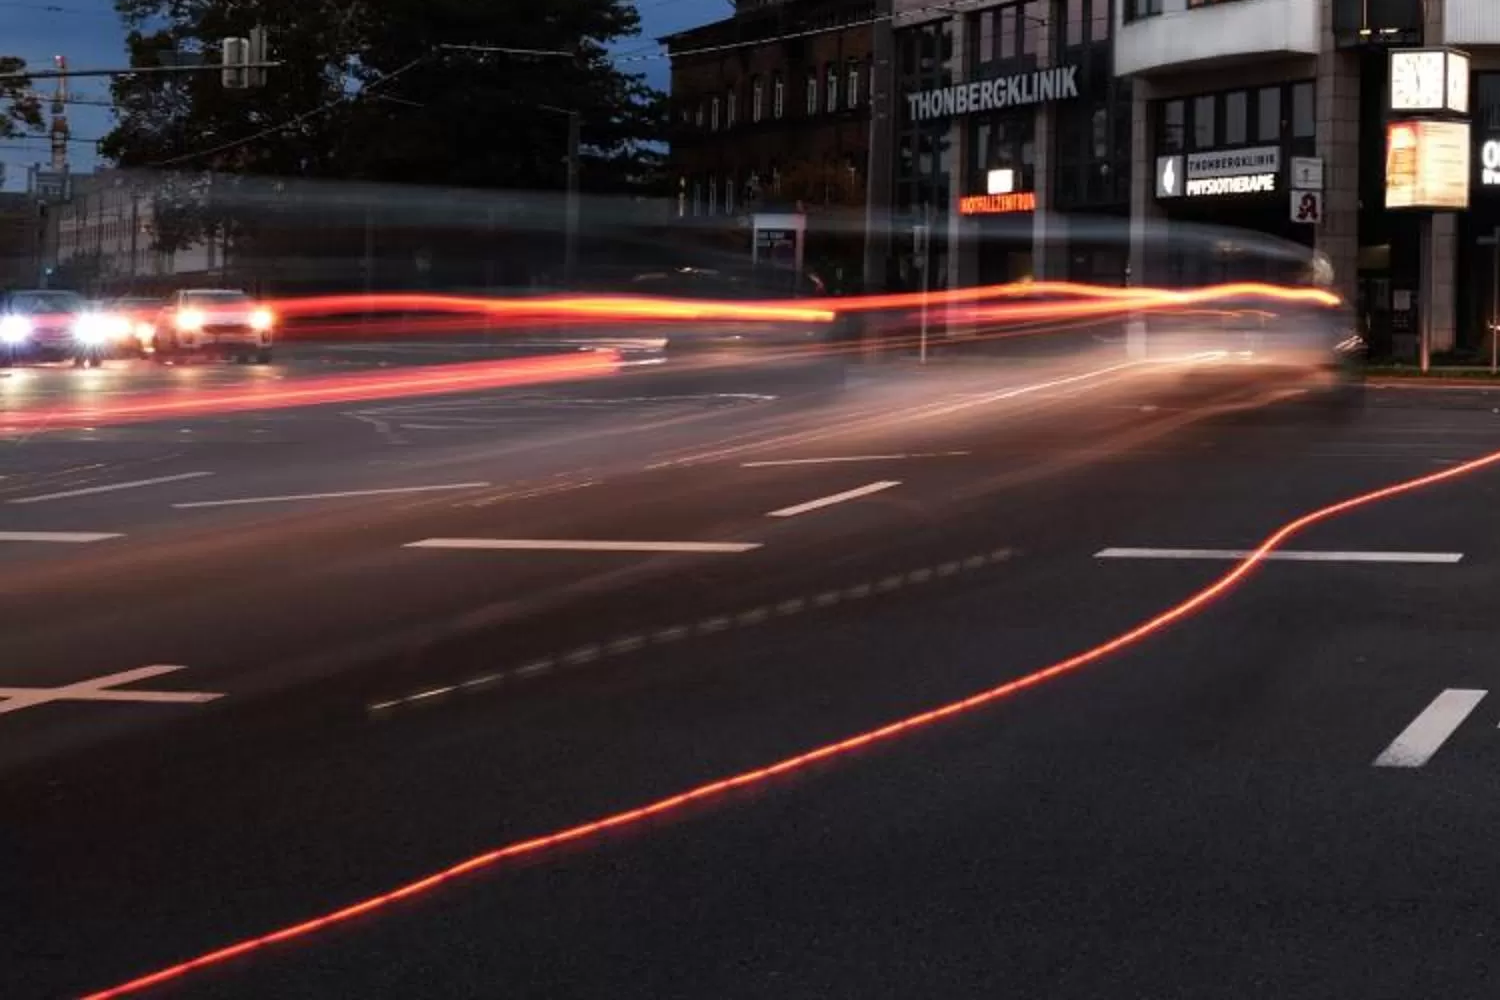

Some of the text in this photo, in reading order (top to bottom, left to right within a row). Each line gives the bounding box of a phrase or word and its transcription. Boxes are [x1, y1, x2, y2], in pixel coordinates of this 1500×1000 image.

[907, 65, 1079, 121] THONBERGKLINIK
[1189, 153, 1276, 172] THONBERGKLINIK
[1186, 174, 1275, 197] PHYSIOTHERAPIE
